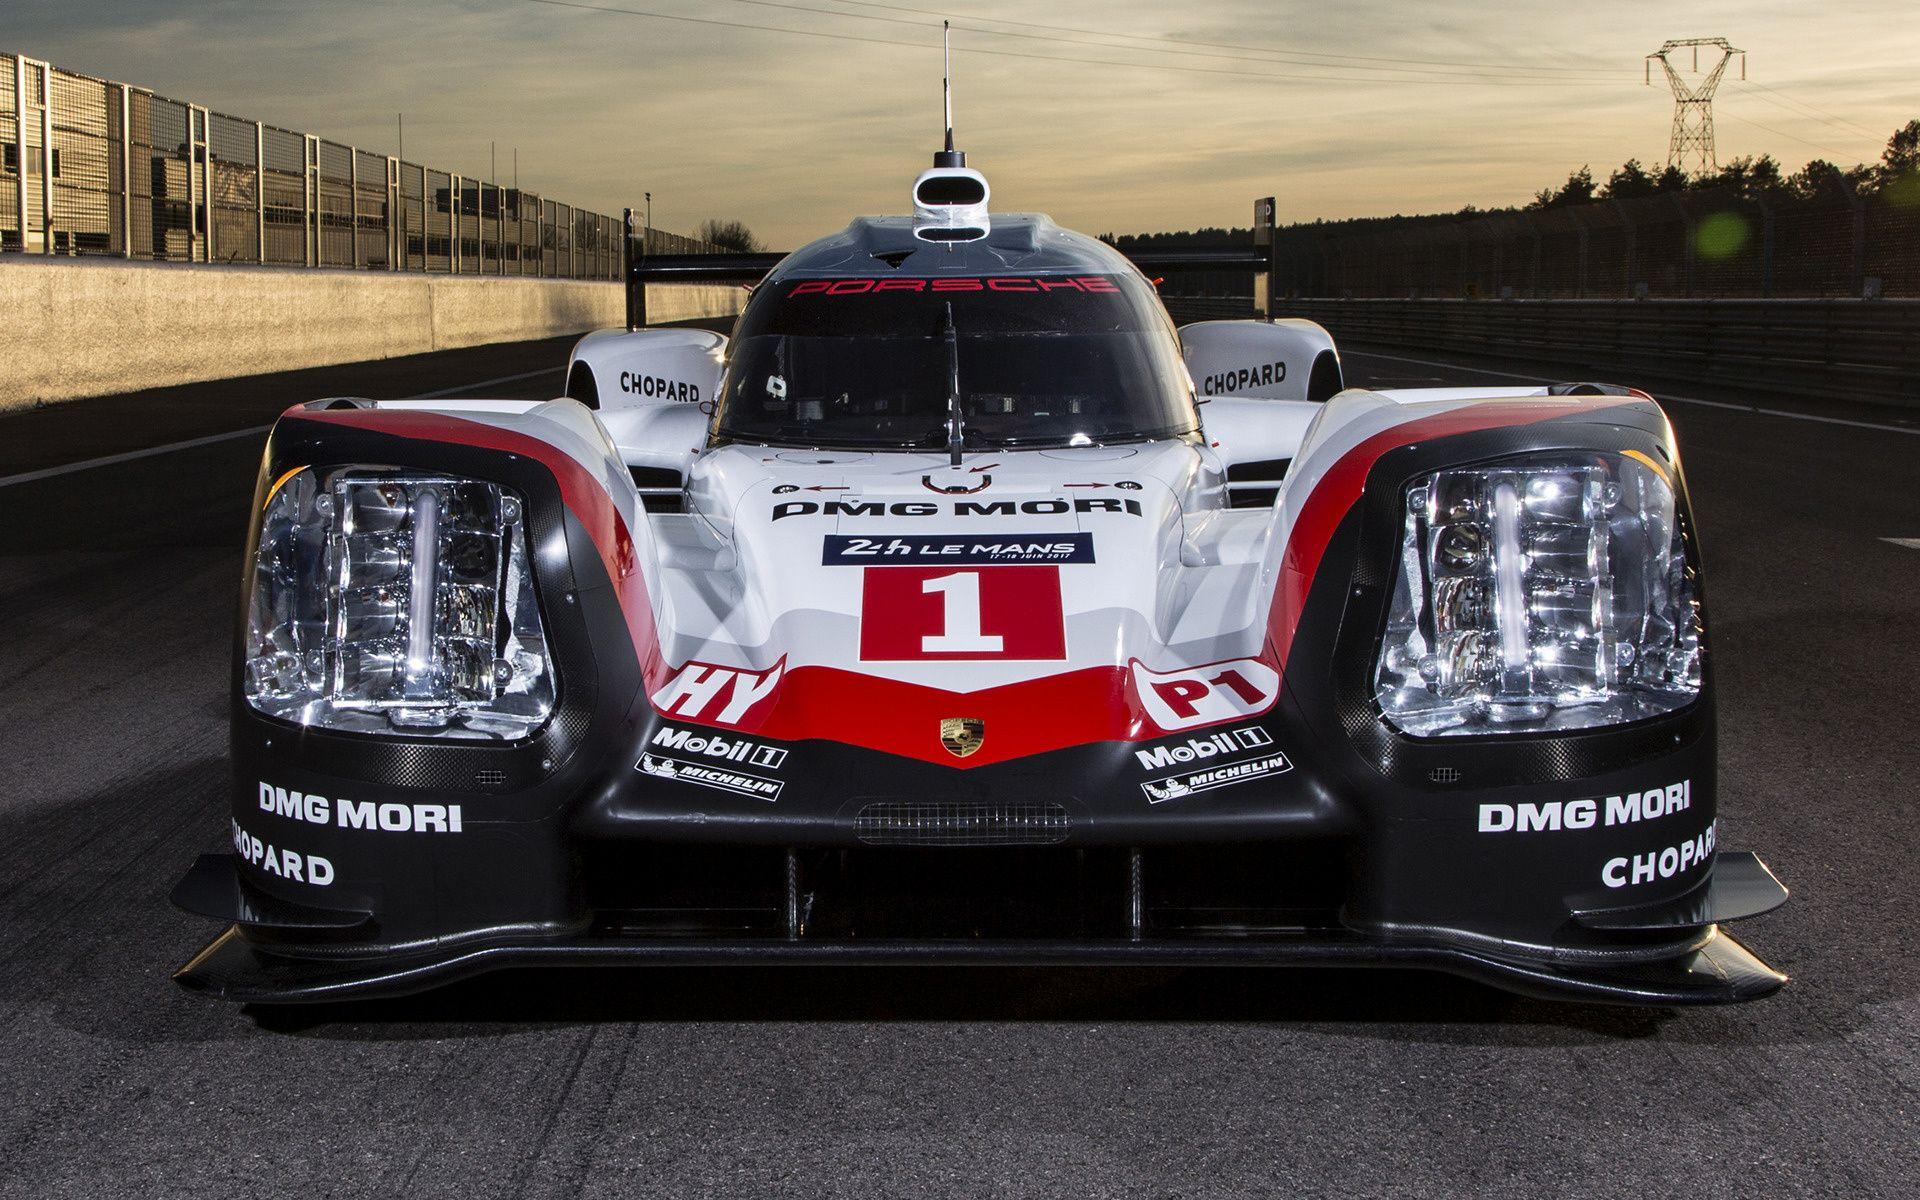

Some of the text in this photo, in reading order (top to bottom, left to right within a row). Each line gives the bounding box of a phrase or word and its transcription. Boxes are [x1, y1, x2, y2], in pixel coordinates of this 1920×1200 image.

[787, 277, 1121, 298] PORSCHE
[620, 371, 700, 402] CHOPARD
[1204, 361, 1287, 395] CHOPARD
[772, 499, 1143, 522] DMG MORI
[919, 545, 964, 555] LE
[970, 543, 1075, 554] MANS
[922, 572, 1004, 652] 1
[651, 664, 783, 725] HY
[1150, 669, 1267, 719] P1
[652, 727, 753, 762] Mobil
[1135, 732, 1239, 771] Mobil
[680, 766, 779, 793] MICHELIN
[1189, 757, 1284, 786] MICHELIN
[259, 781, 463, 832] DMG MORI
[1478, 779, 1690, 832] DMG MORI
